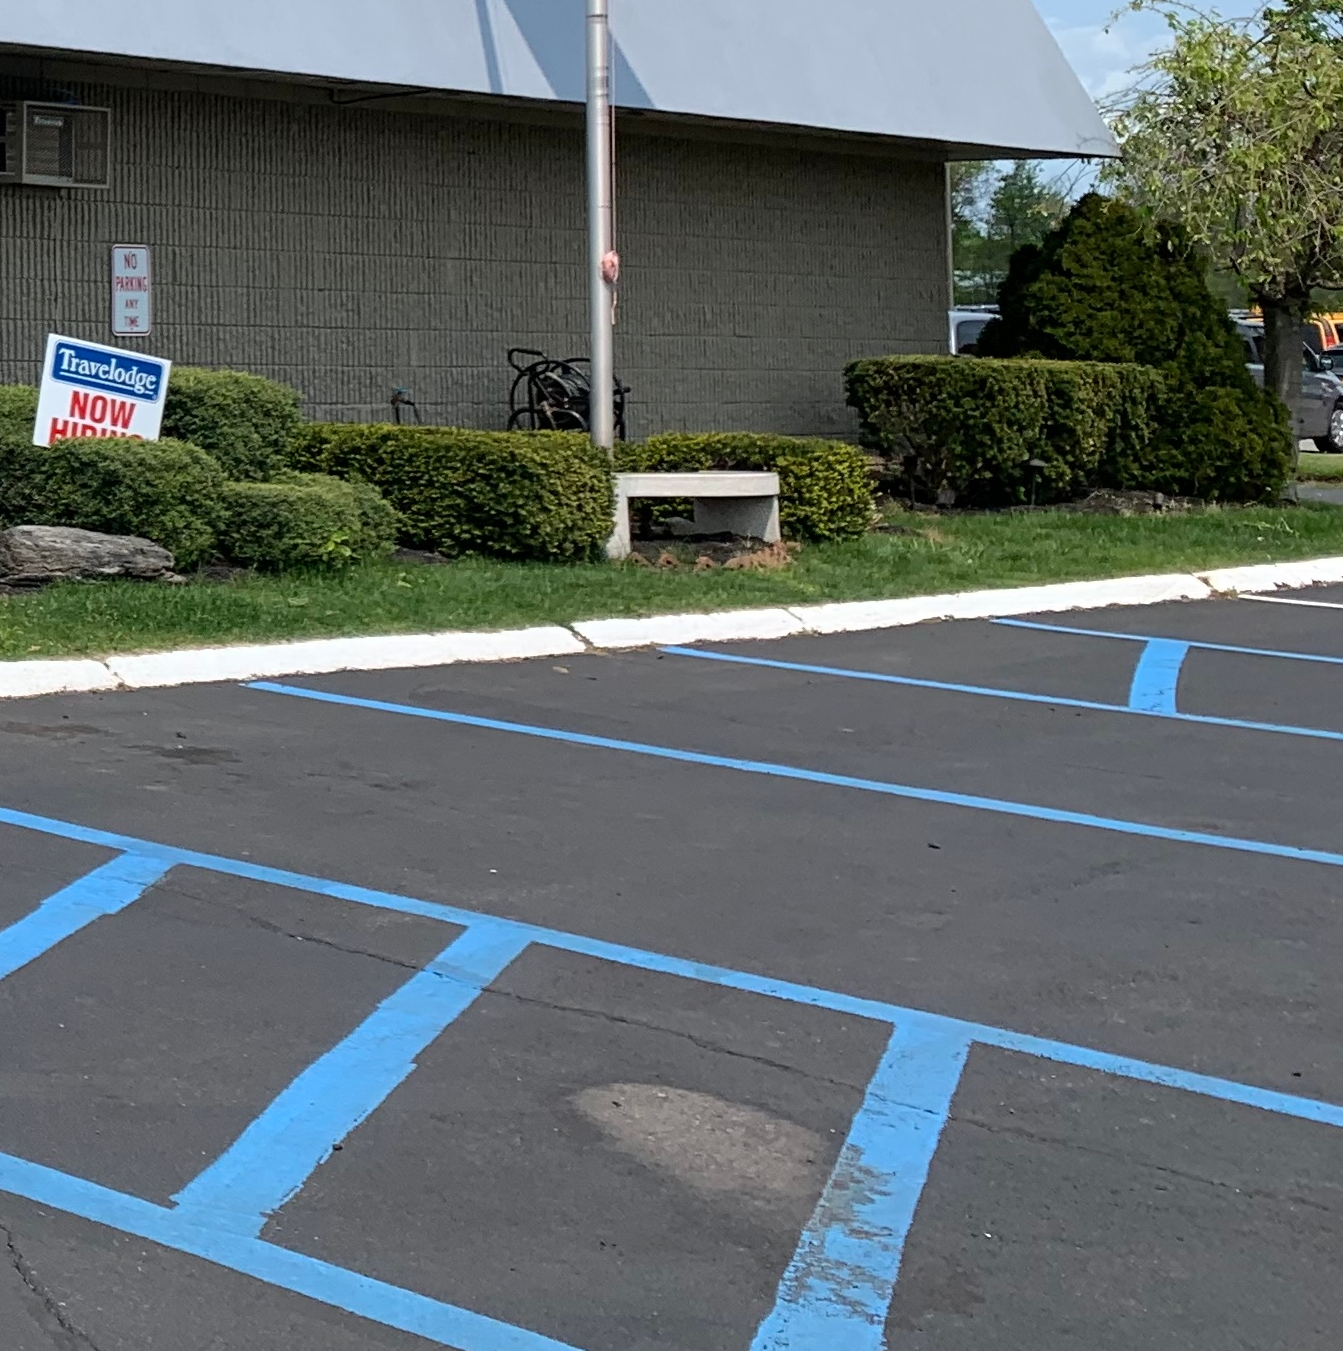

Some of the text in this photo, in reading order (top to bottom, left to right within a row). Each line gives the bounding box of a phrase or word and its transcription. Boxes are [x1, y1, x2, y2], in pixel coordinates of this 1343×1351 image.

[123, 253, 137, 269] NO
[115, 276, 147, 292] PARKING
[125, 299, 138, 309] ANY
[124, 315, 139, 327] TIME
[58, 348, 157, 394] Travelodge
[69, 390, 136, 429] NOW
